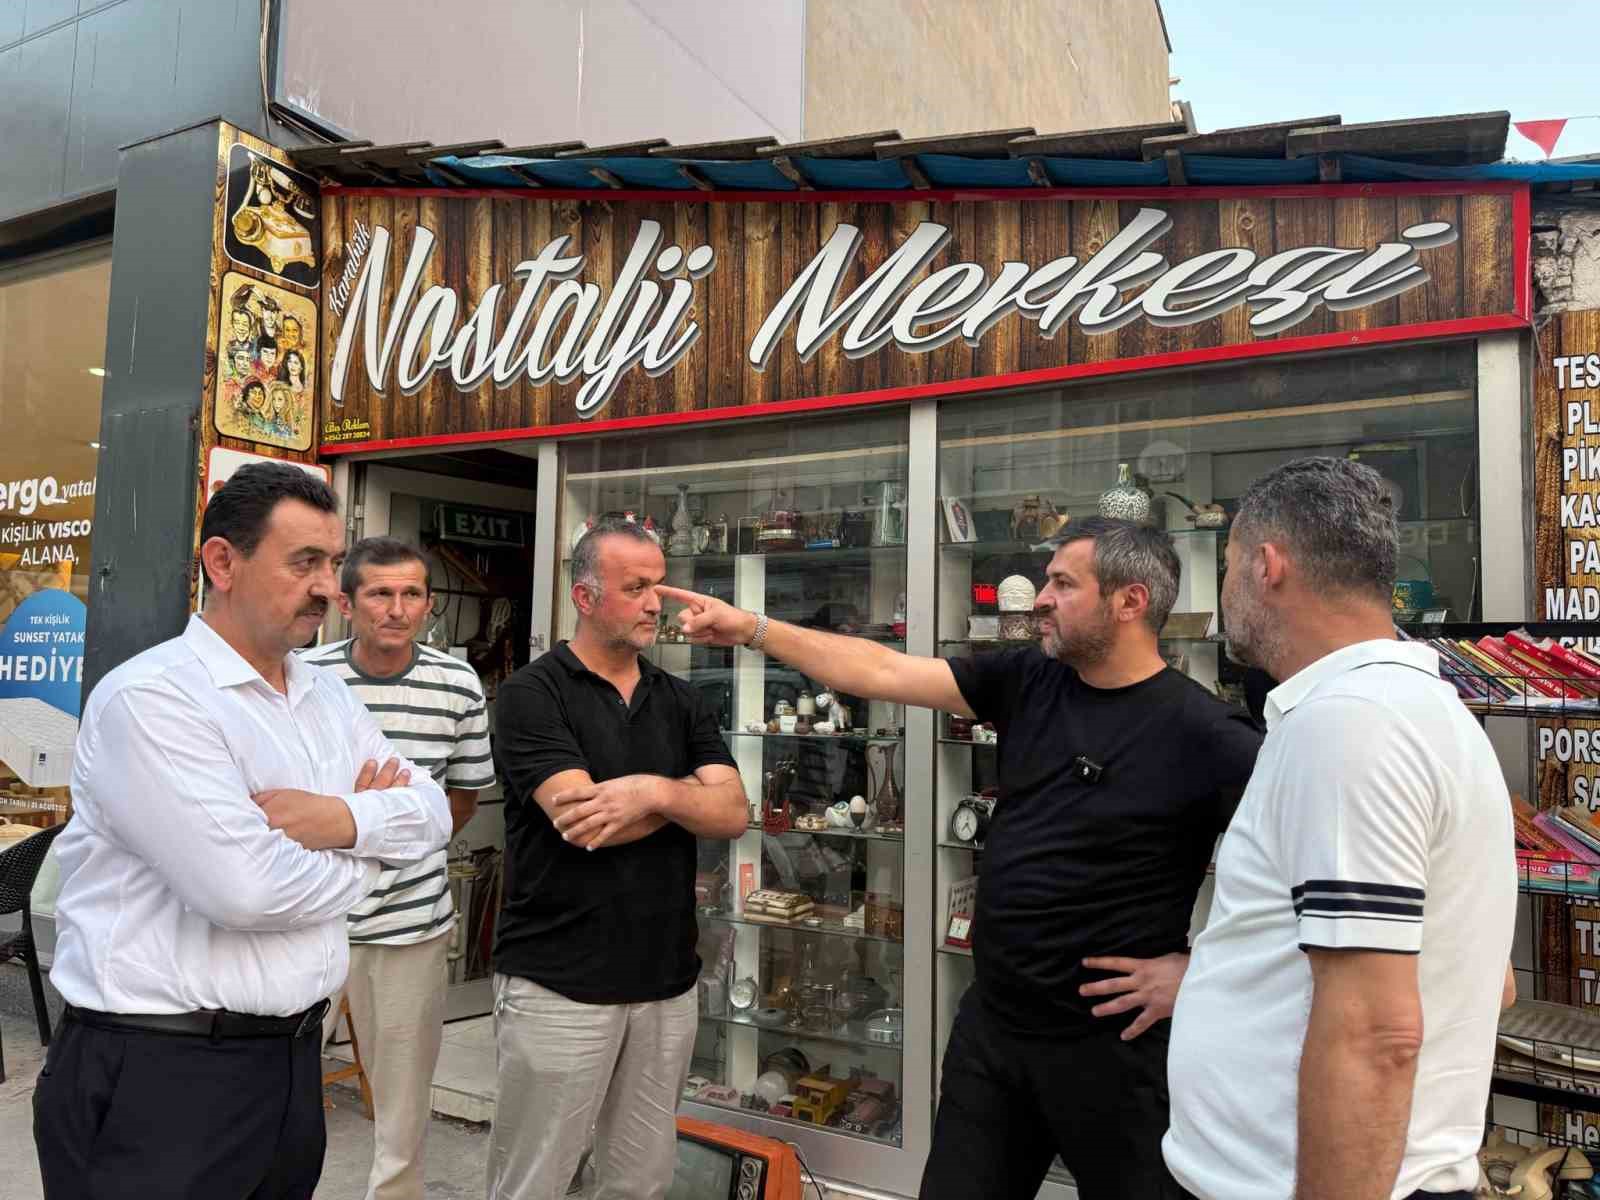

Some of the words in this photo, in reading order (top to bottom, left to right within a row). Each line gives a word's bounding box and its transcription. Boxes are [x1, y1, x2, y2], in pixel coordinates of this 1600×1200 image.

[329, 219, 371, 317] Karabük
[331, 219, 714, 413] Nostalji
[749, 207, 1455, 367] Merkezi
[1553, 355, 1600, 390] TES
[1567, 401, 1600, 436] PL
[1, 520, 46, 547] KİŞİLİK
[48, 519, 92, 540] VISCO
[455, 512, 511, 538] EXIT
[21, 543, 79, 566] ALANA,
[1545, 587, 1600, 620] MAD
[30, 615, 43, 625] TEK
[44, 613, 70, 627] KİŞİLİK
[13, 631, 50, 643] SUNSET
[52, 631, 85, 643] YATAK
